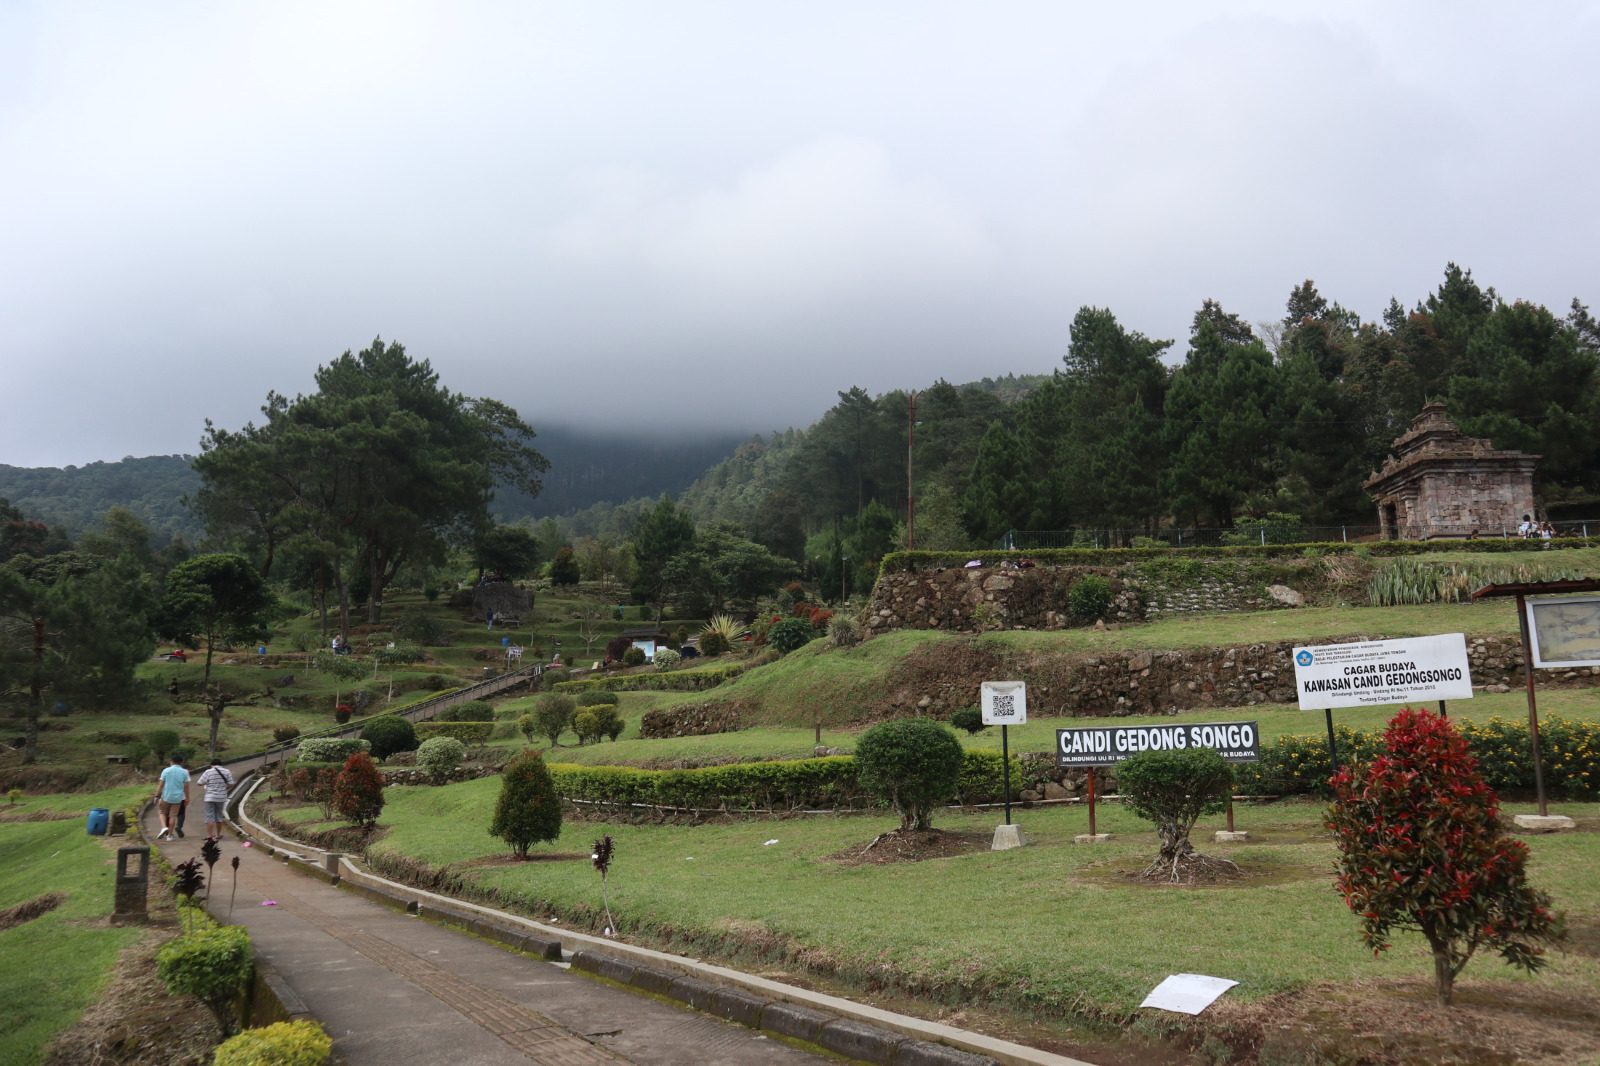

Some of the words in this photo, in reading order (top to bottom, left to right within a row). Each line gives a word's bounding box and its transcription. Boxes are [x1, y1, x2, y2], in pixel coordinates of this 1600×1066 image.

[1304, 678, 1351, 692] KAWASAN
[1354, 674, 1384, 688] CANDI
[1386, 668, 1462, 686] GEDONGSONGO
[1344, 664, 1376, 676] CAGAR
[1380, 662, 1416, 672] BUDAYA
[1060, 731, 1110, 754] CANDI
[1115, 727, 1186, 752] GEDONG
[1190, 724, 1254, 749] SONGO
